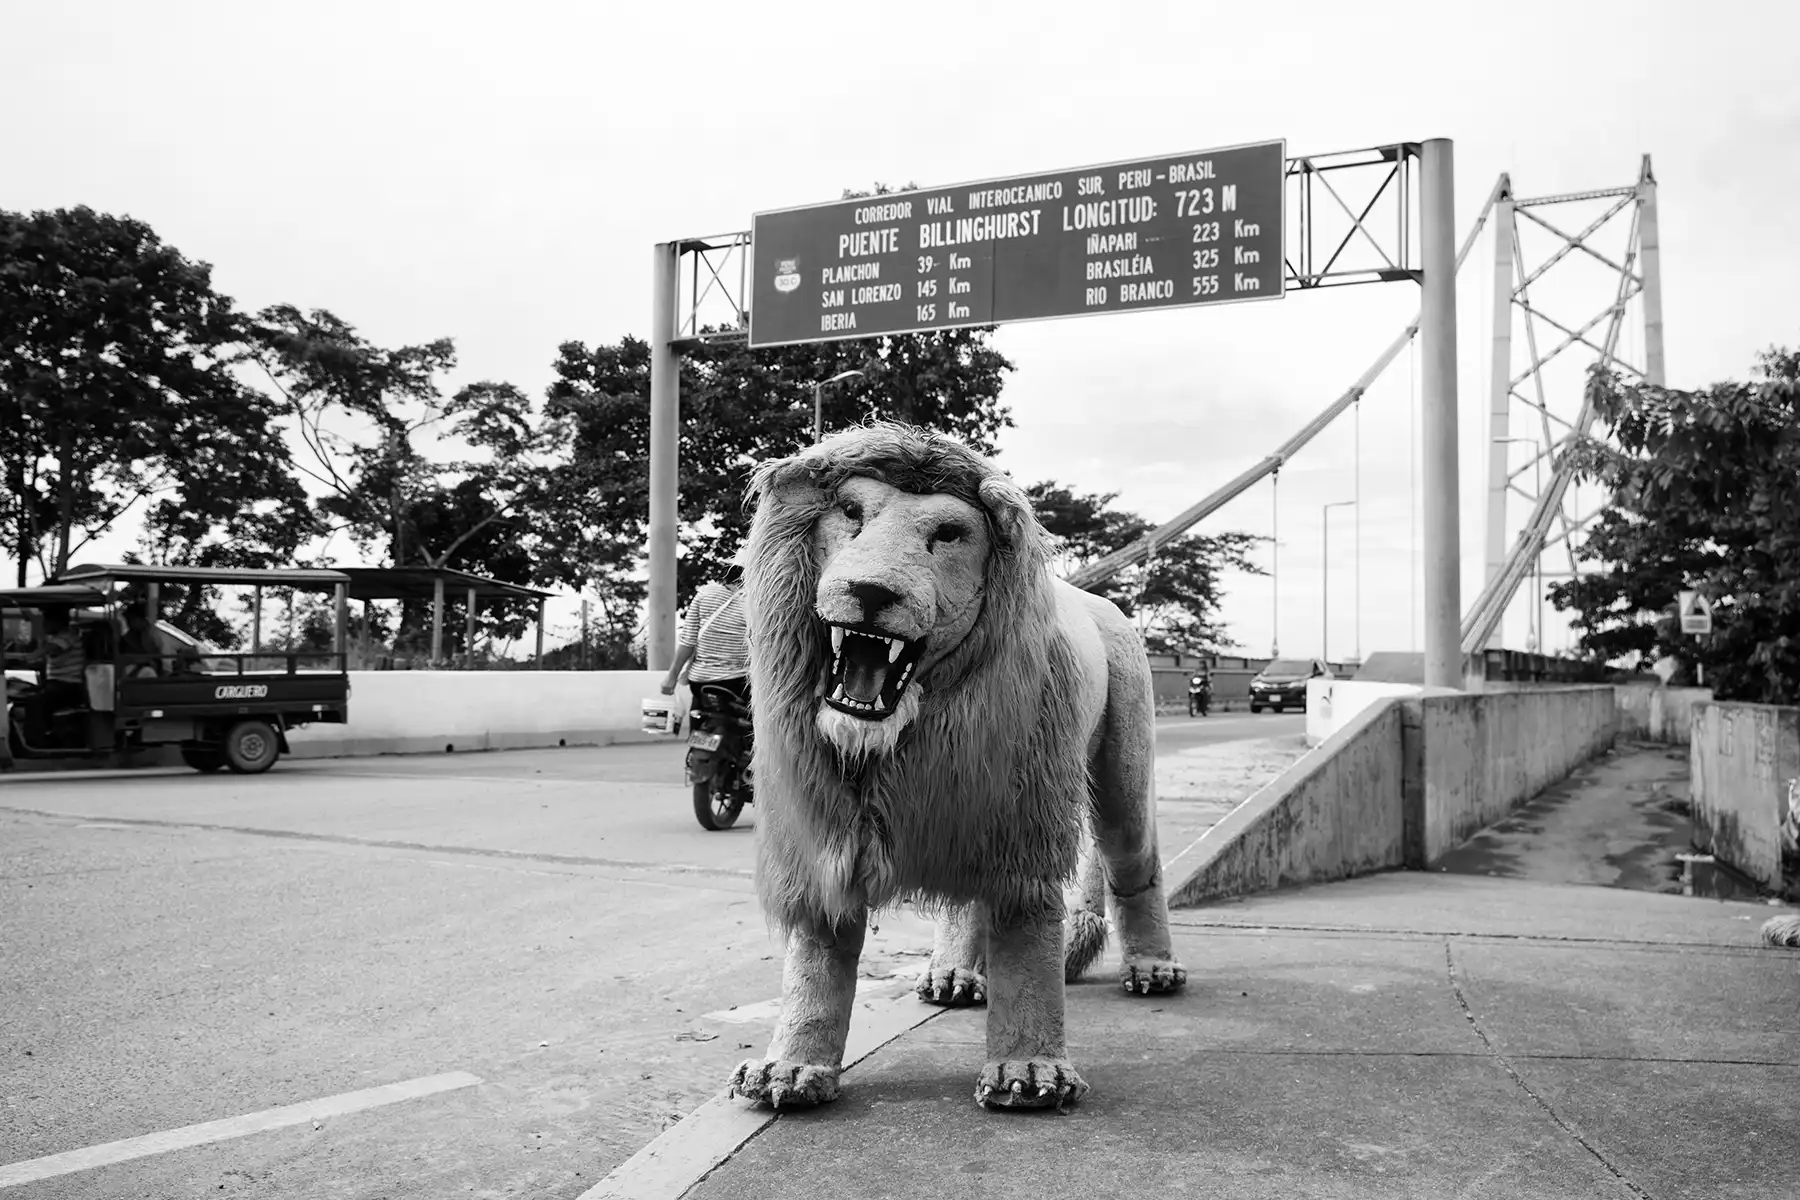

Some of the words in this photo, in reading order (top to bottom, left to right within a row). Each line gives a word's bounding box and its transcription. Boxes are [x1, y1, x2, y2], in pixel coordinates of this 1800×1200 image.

[855, 202, 912, 225] CORREDOR
[927, 197, 953, 215] VIAL
[969, 181, 1062, 209] INTEROCEANICO
[1119, 169, 1151, 190] PERU
[1169, 161, 1216, 184] BRASIL
[840, 228, 899, 258] PUENTE
[920, 210, 1040, 248] BILLINGHURST
[1063, 196, 1157, 231] LONGITUD:
[1175, 188, 1214, 218] 723
[1222, 185, 1236, 212] M
[1087, 232, 1137, 255] IÑAPARI
[1193, 222, 1219, 243] 223
[1235, 219, 1259, 238] Km
[822, 263, 879, 284] PLANCHON
[950, 253, 971, 270] Km
[1087, 255, 1153, 280] BRASILÉIA
[1193, 249, 1219, 269] 325
[1235, 246, 1259, 265] Km
[822, 290, 844, 308] SAN
[852, 284, 901, 305] LORENZO
[917, 280, 937, 298] 145
[949, 277, 970, 294] Km
[1086, 287, 1106, 306] RIO
[1121, 280, 1173, 302] BRANCO
[1193, 276, 1218, 295] 555
[1235, 273, 1259, 291] Km
[821, 312, 856, 331] IBERIA
[917, 305, 936, 322] 165
[949, 302, 970, 319] Km
